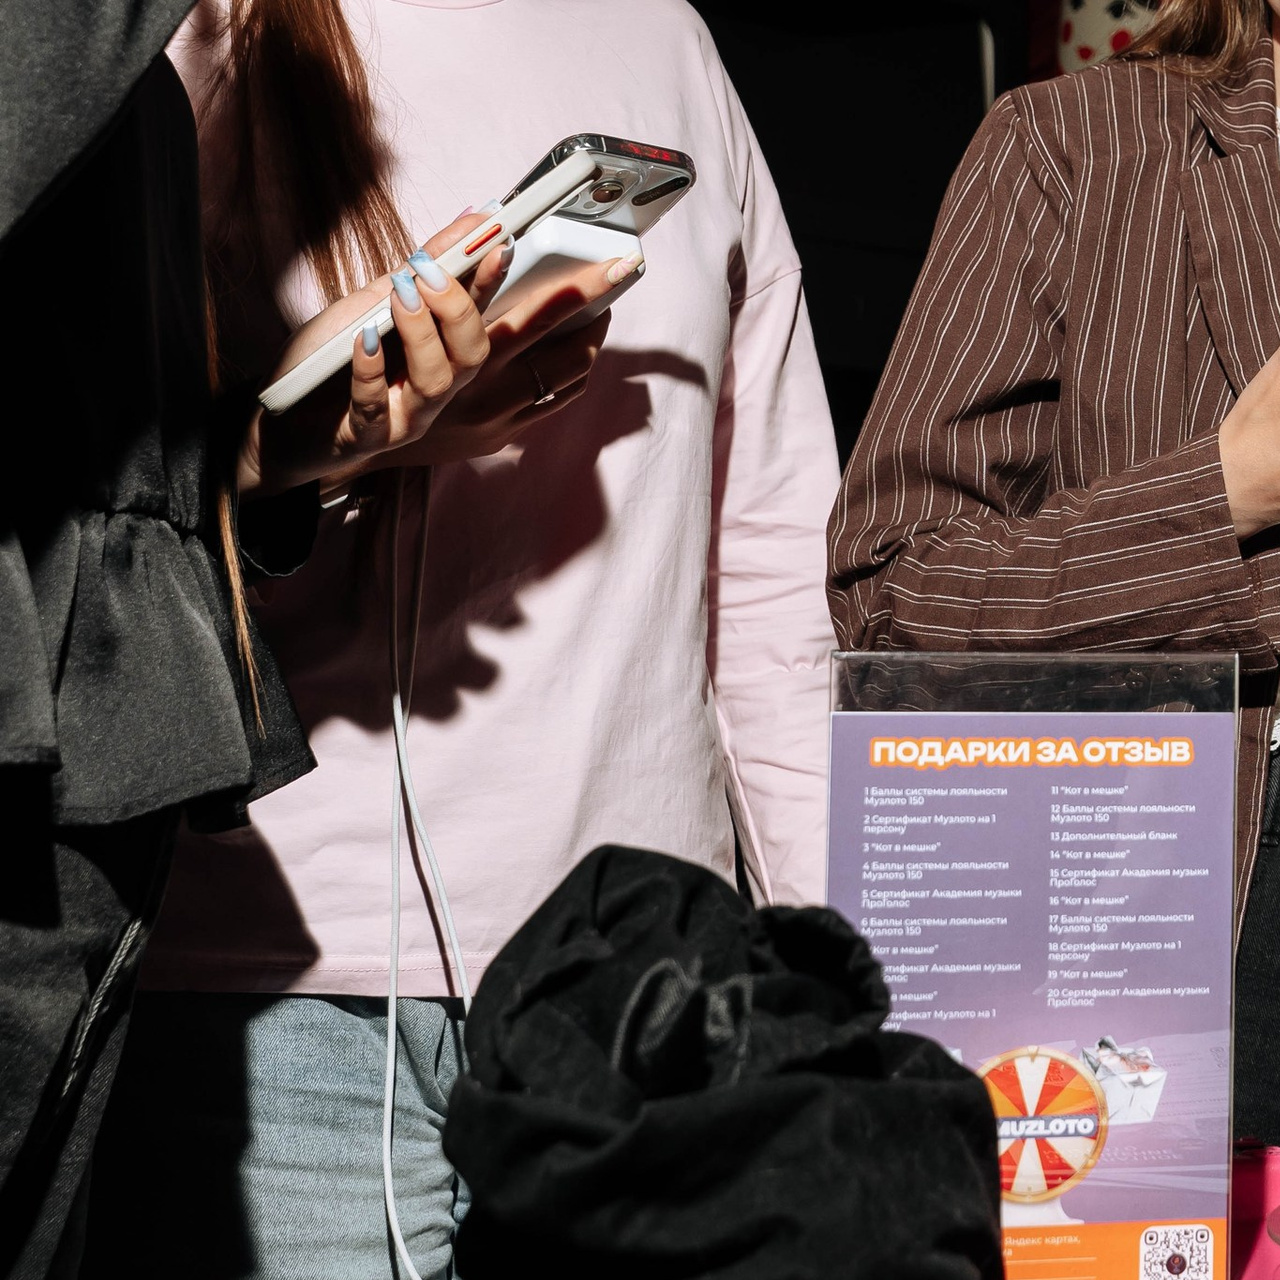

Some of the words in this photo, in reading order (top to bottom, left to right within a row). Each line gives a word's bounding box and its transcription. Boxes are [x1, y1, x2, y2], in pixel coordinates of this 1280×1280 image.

[873, 740, 1030, 766] ПОДАРКИ
[1036, 740, 1078, 762] ЗА
[1083, 740, 1190, 763] ОТЗЫВ
[871, 787, 903, 796] Баллы
[905, 788, 948, 796] системы
[1051, 786, 1059, 795] 11
[864, 797, 907, 807] Музлото
[909, 797, 925, 805] 150
[1051, 805, 1060, 813] 12
[1062, 805, 1094, 813] Баллы
[872, 815, 932, 825] Сертификат
[934, 815, 976, 825] Музлото
[1051, 814, 1093, 824] Музлото
[1094, 814, 1110, 822] 150
[863, 826, 907, 834] персону
[1051, 832, 1060, 841] 13
[1061, 831, 1146, 841] Дополнительный
[1148, 831, 1178, 840] бланк
[1050, 850, 1060, 859] 14
[872, 861, 904, 870] Баллы
[906, 862, 949, 870] системы
[951, 862, 1009, 870] лояльности
[862, 871, 905, 881] Музлото
[907, 871, 923, 879] 150
[1050, 869, 1060, 878] 15
[1061, 868, 1120, 879] Сертификат
[1122, 868, 1171, 877] Академия
[1172, 868, 1209, 878] музыки
[870, 889, 930, 899] Сертификат
[932, 889, 983, 898] Академия
[984, 889, 1022, 899] музыки
[1049, 897, 1059, 906] 16
[871, 918, 903, 926] Баллы
[905, 918, 948, 926] системы
[1049, 915, 1059, 923] 17
[1061, 915, 1093, 923] Баллы
[1094, 915, 1137, 923] системы
[1138, 914, 1194, 922] лояльности
[861, 927, 904, 938] Музлото
[905, 926, 922, 936] 150
[1049, 924, 1091, 934] Музлото
[1092, 924, 1108, 932] 150
[1049, 942, 1059, 951] 18
[1060, 942, 1119, 952] Сертификат
[1121, 942, 1162, 951] Музлото
[1048, 953, 1090, 962] персону
[884, 963, 929, 974] тификат
[931, 963, 982, 972] Академия
[984, 963, 1021, 974] музыки
[1048, 970, 1058, 979] 19
[1047, 988, 1060, 997] 20
[1061, 988, 1121, 998] Сертификат
[1122, 987, 1172, 996] Академия
[1173, 987, 1210, 997] музыки
[891, 1010, 931, 1021] тификат
[934, 1010, 976, 1020] Музлото
[978, 1010, 991, 1019] на
[1004, 1236, 1042, 1247] Яндекс
